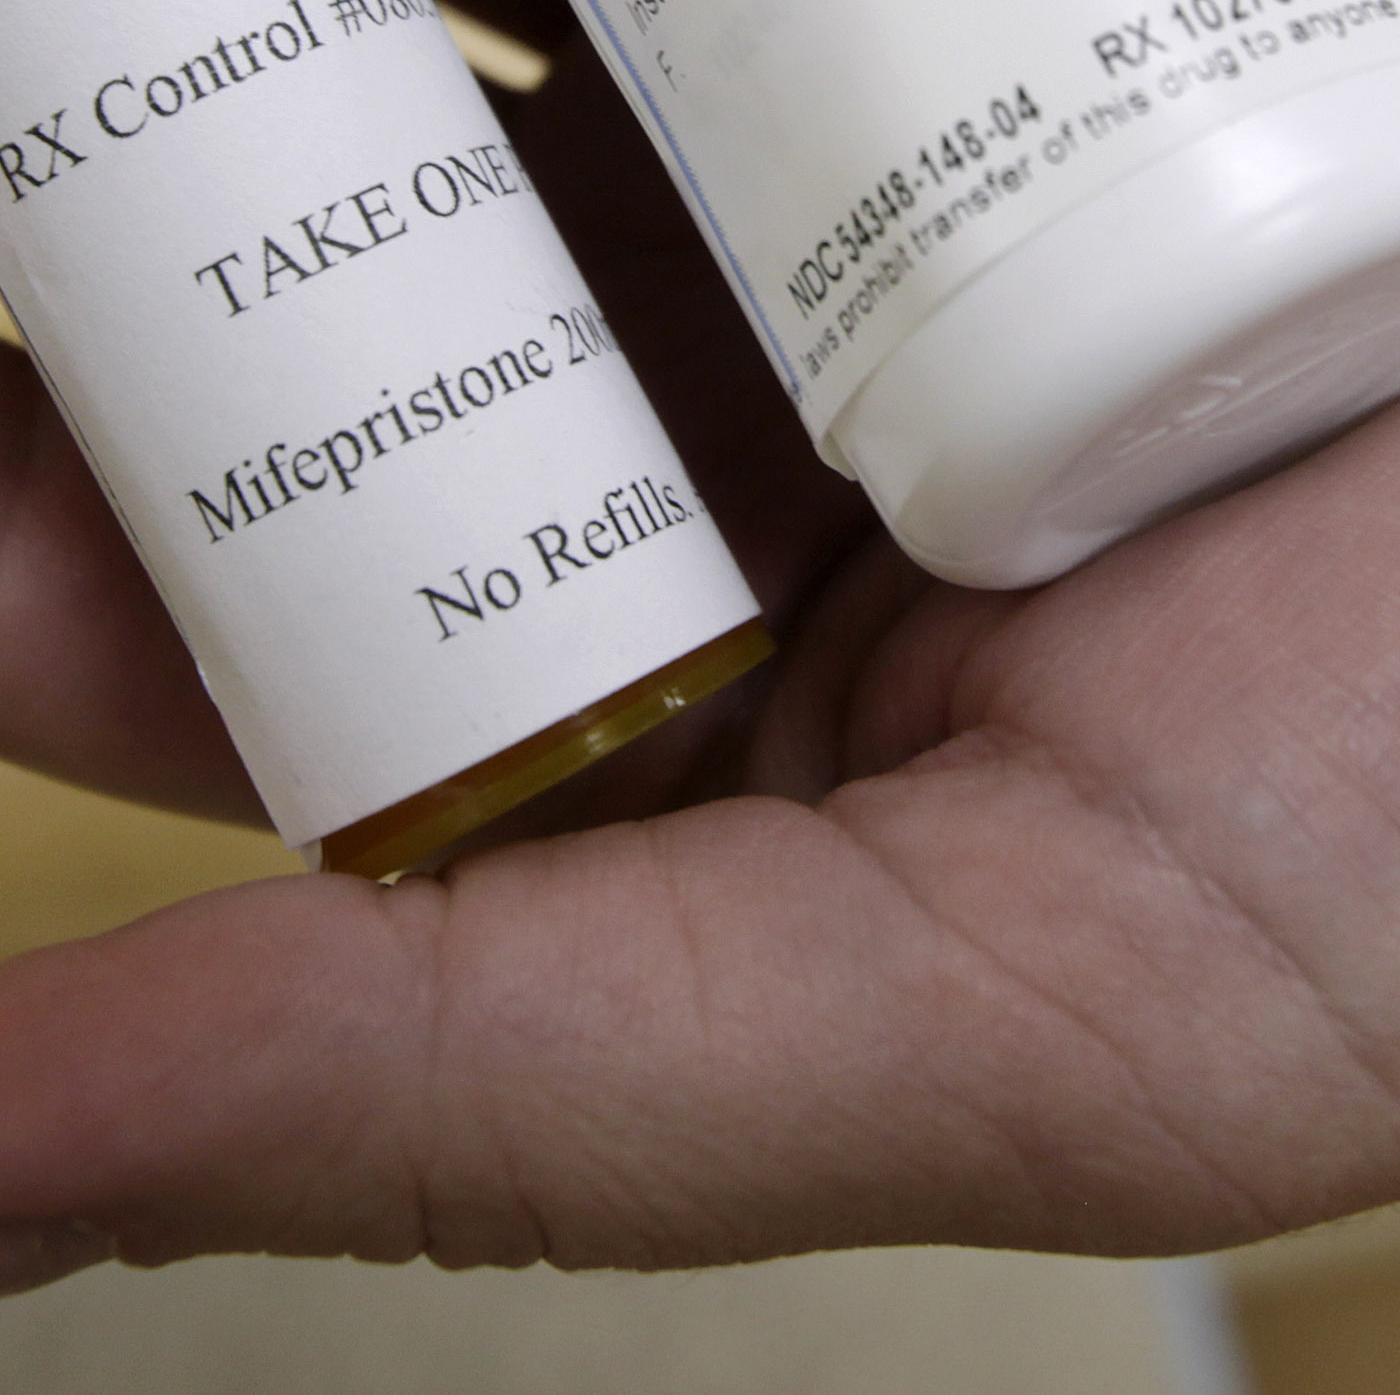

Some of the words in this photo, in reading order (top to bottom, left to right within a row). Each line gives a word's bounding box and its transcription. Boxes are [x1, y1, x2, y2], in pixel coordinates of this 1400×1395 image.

[1090, 17, 1170, 77] RX
[193, 180, 410, 318] TAKE
[412, 144, 519, 217] ONE
[837, 243, 915, 341] prohibit
[913, 155, 1034, 258] transfer
[1042, 122, 1080, 167] of
[1081, 87, 1150, 141] this
[1160, 37, 1241, 100] drug
[1241, 19, 1281, 62] to
[184, 338, 553, 546] Mifepristone
[550, 303, 619, 365] 200
[412, 564, 522, 643] No
[523, 475, 694, 589] Refills.
